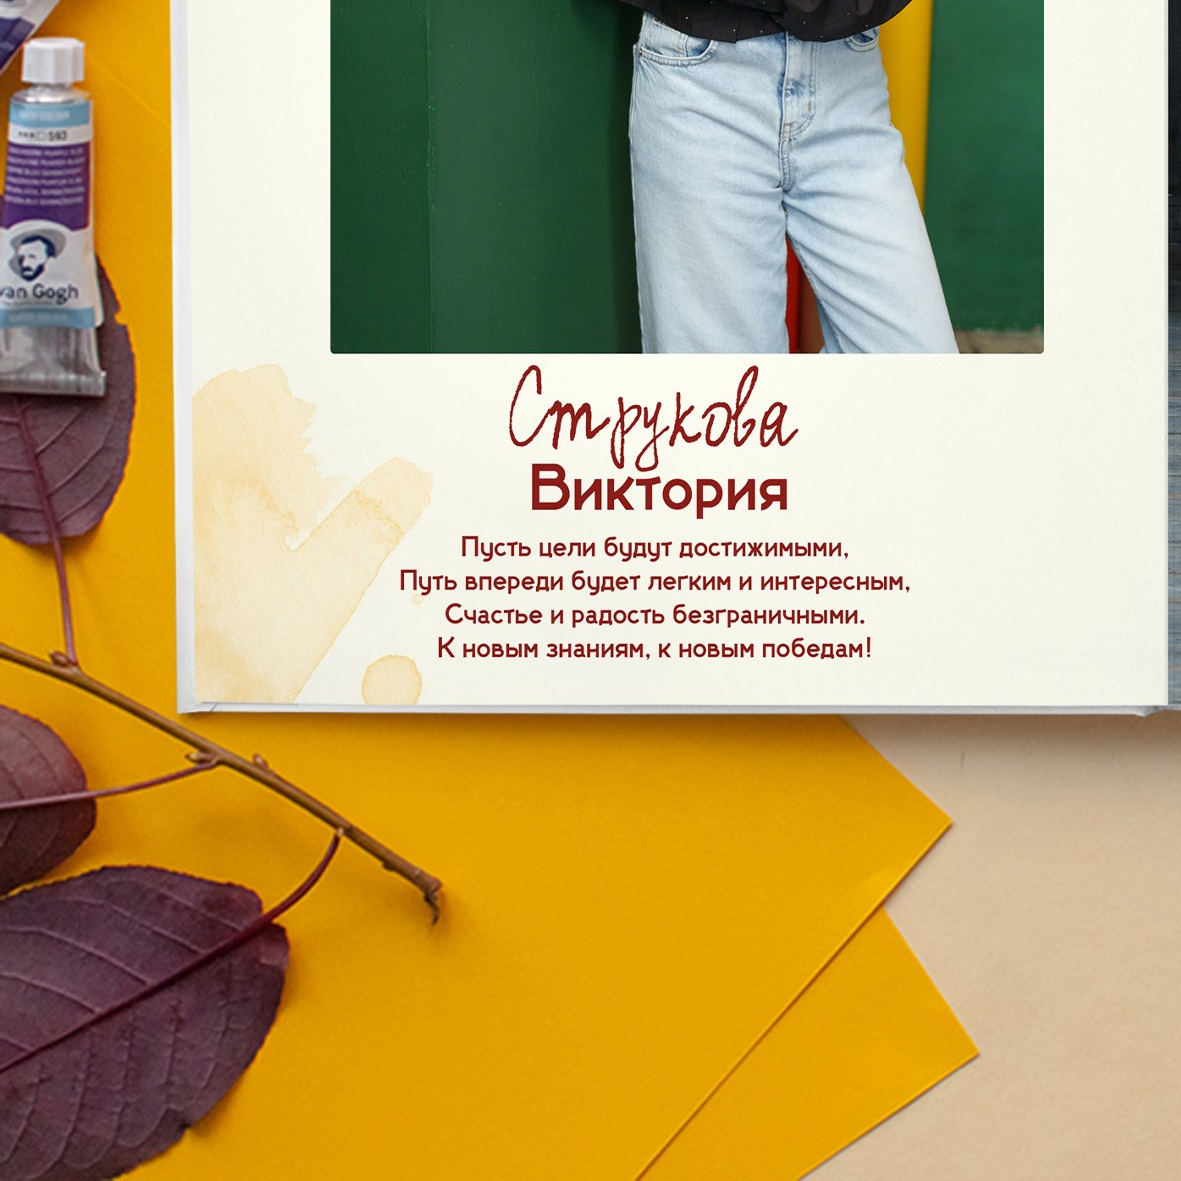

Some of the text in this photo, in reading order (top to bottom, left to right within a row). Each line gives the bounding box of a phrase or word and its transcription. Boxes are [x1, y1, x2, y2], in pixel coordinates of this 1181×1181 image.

[32, 283, 79, 305] Gogh
[509, 364, 799, 472] Струкова
[531, 464, 788, 519] Виктория
[461, 535, 850, 563] Пусть цели будут достижимыми,
[399, 569, 911, 597] Путь впереди будет легким и интересным,
[444, 603, 865, 628] Счастье и радость безграничными.
[437, 636, 872, 660] К новым знаниям, к новым победам!
